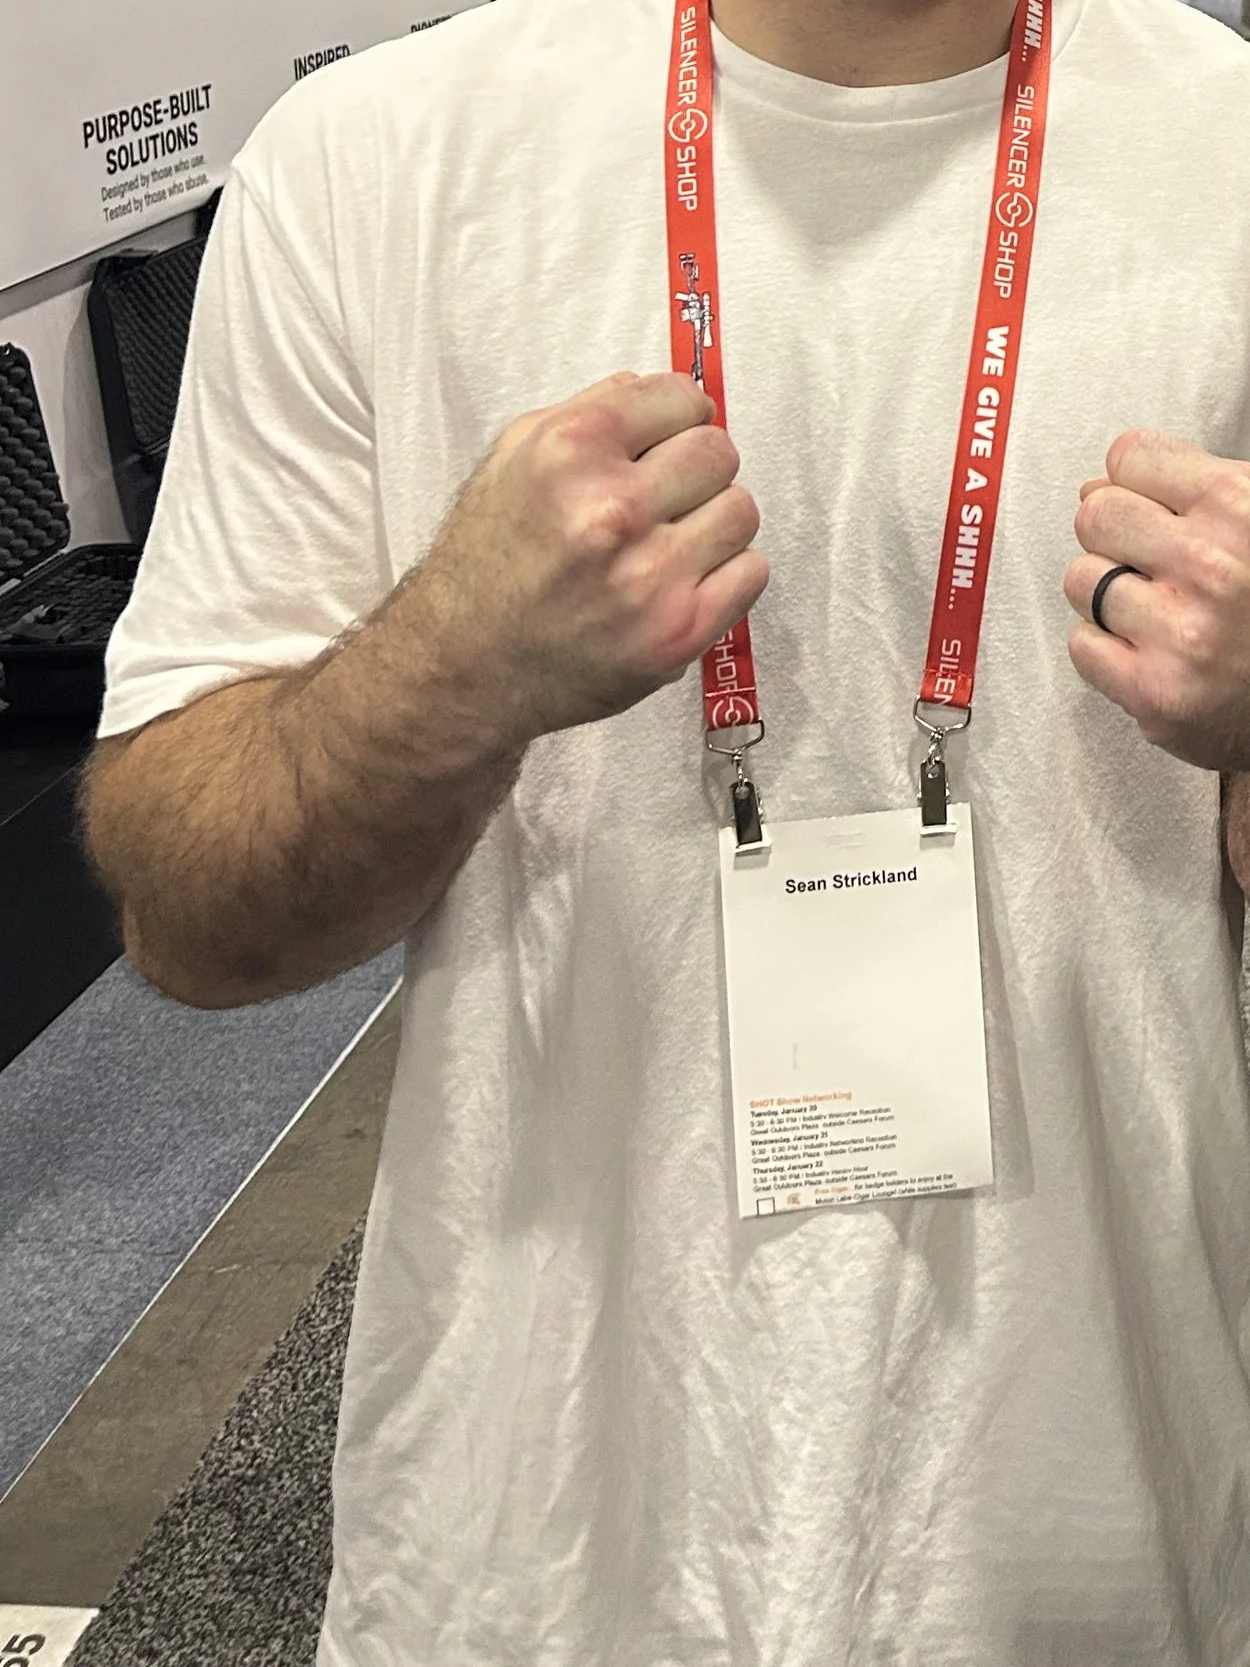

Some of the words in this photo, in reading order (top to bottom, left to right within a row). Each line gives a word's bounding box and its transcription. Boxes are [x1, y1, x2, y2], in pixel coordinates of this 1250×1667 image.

[678, 6, 698, 107] SILENCER
[82, 84, 212, 149] PURPOSE-BUILT
[105, 121, 199, 175] SOLUTIONS
[1006, 84, 1036, 189] SILENCER
[101, 175, 139, 202] Designed
[140, 173, 149, 190] by
[150, 165, 173, 183] those
[174, 158, 190, 174] who
[103, 199, 133, 222] Tested
[134, 197, 143, 213] by
[144, 189, 167, 206] those
[167, 182, 184, 197] who
[676, 144, 698, 211] SHOP
[992, 230, 1019, 300] SHOP
[981, 325, 1010, 377] WE
[970, 387, 1000, 459] GIVE
[964, 467, 988, 492] A
[947, 503, 984, 611] SHHH...
[784, 877, 828, 894] Sean
[832, 866, 919, 890] Strickland
